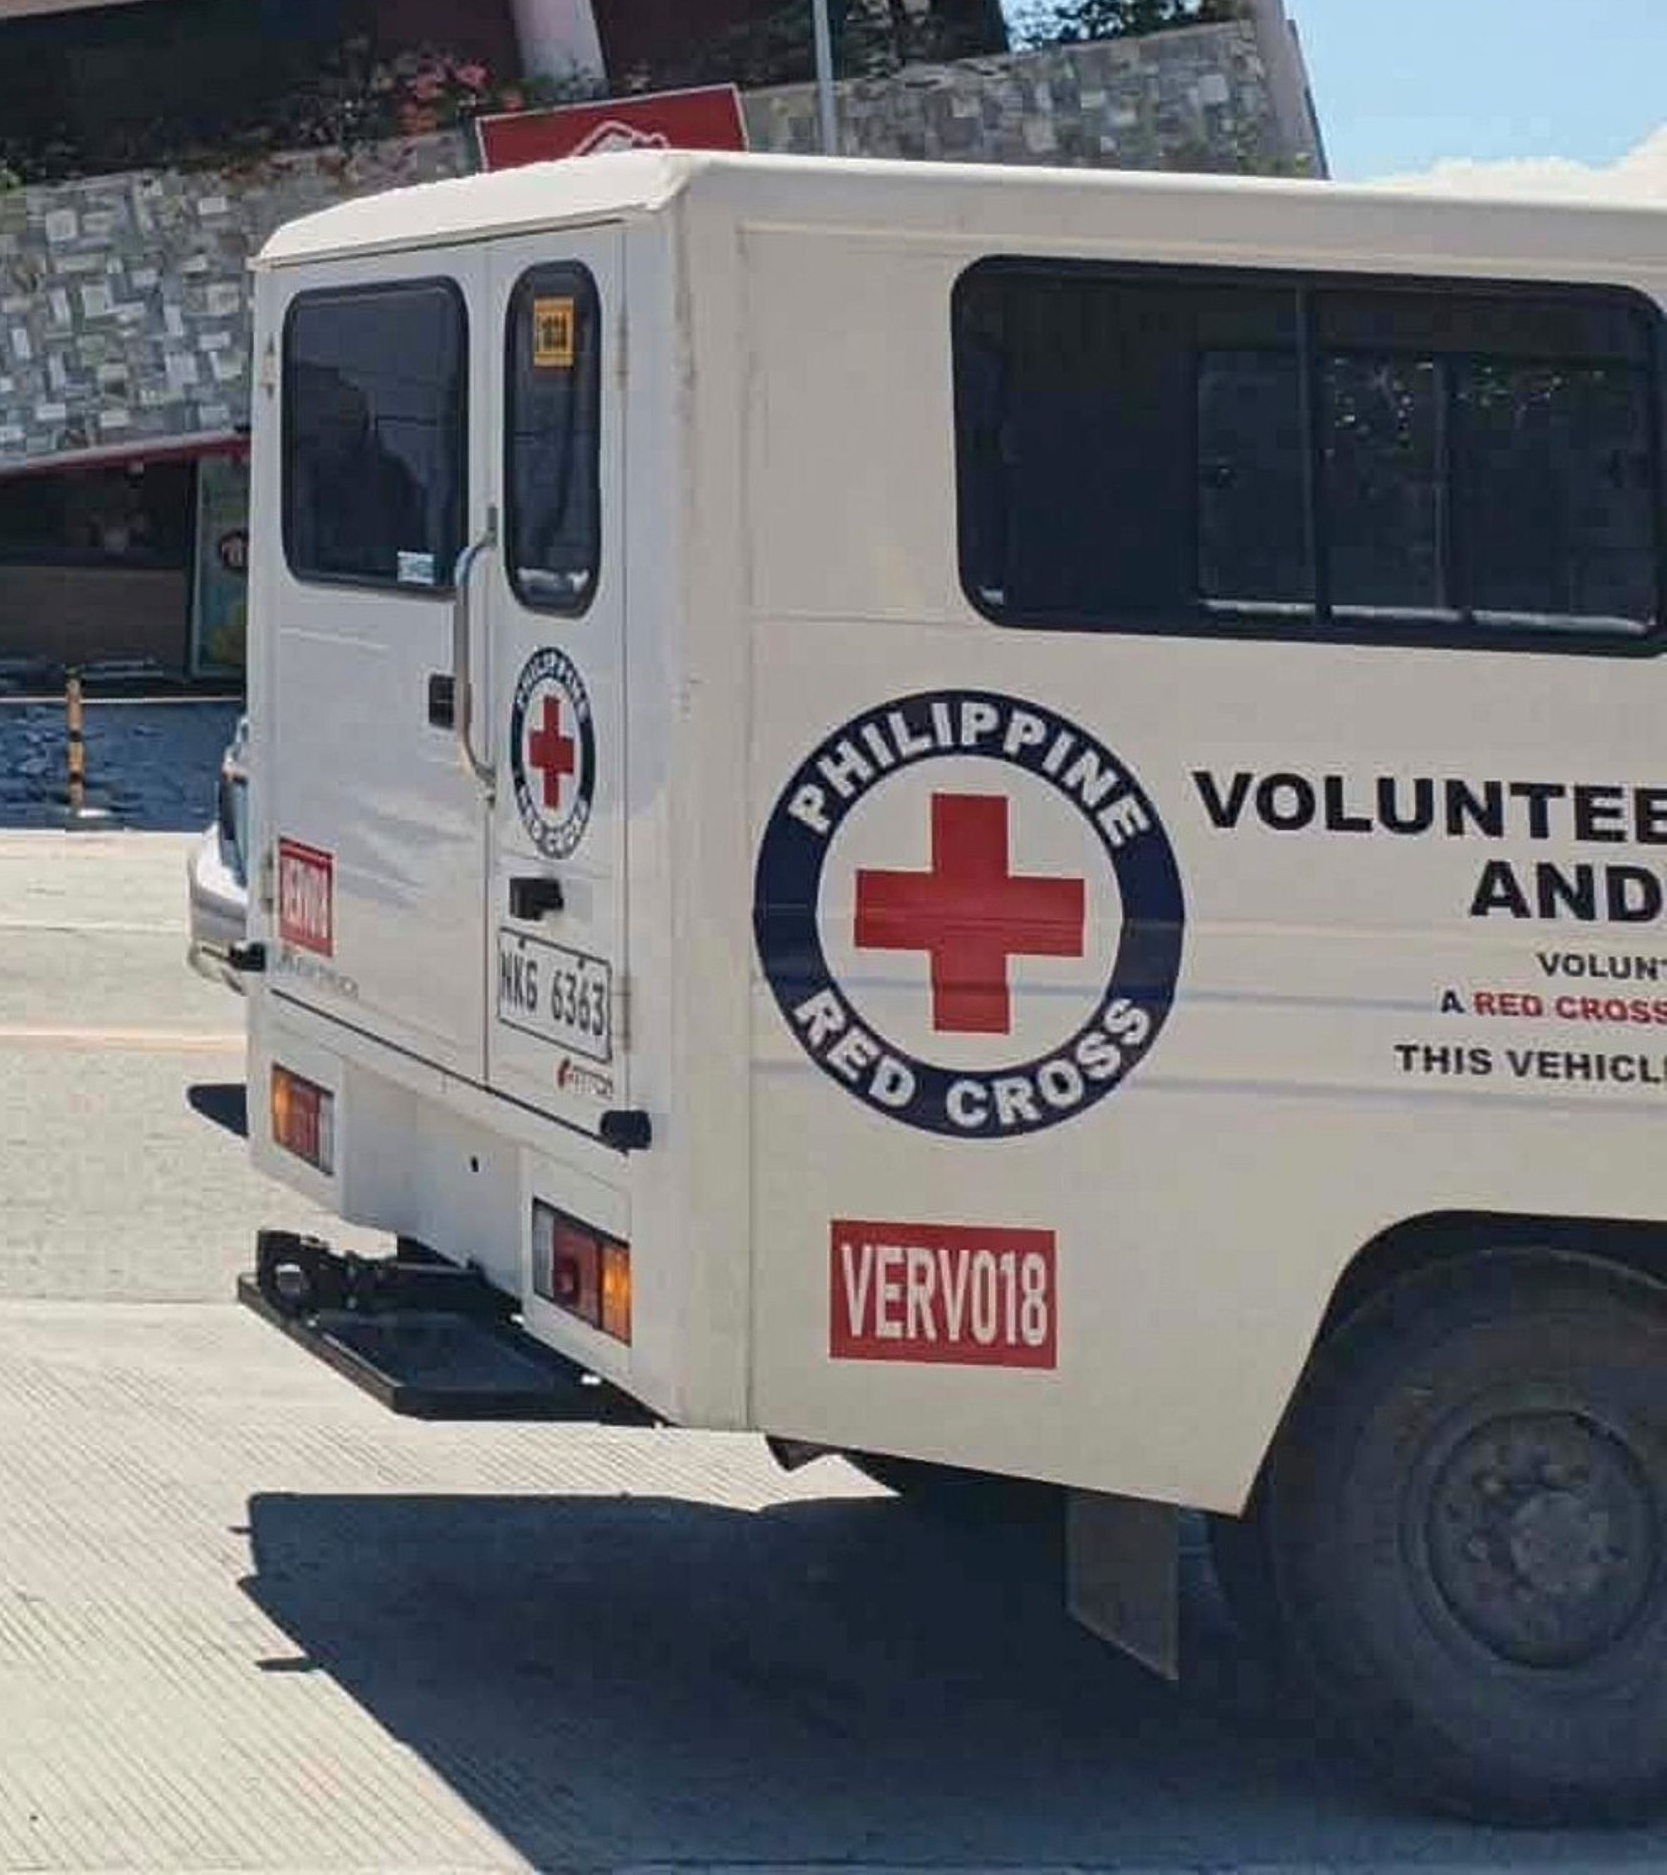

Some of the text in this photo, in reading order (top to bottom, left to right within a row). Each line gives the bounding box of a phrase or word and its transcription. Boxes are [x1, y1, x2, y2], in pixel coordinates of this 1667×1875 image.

[787, 701, 1152, 847] PHILIPPINE
[1469, 859, 1663, 922] AND
[1535, 951, 1667, 981] VOLUN
[1440, 989, 1466, 1014] A
[1473, 991, 1544, 1018] RED
[794, 988, 1151, 1127] RED CROSS
[1394, 1043, 1493, 1075] THIS
[840, 1243, 1048, 1347] VERV018
